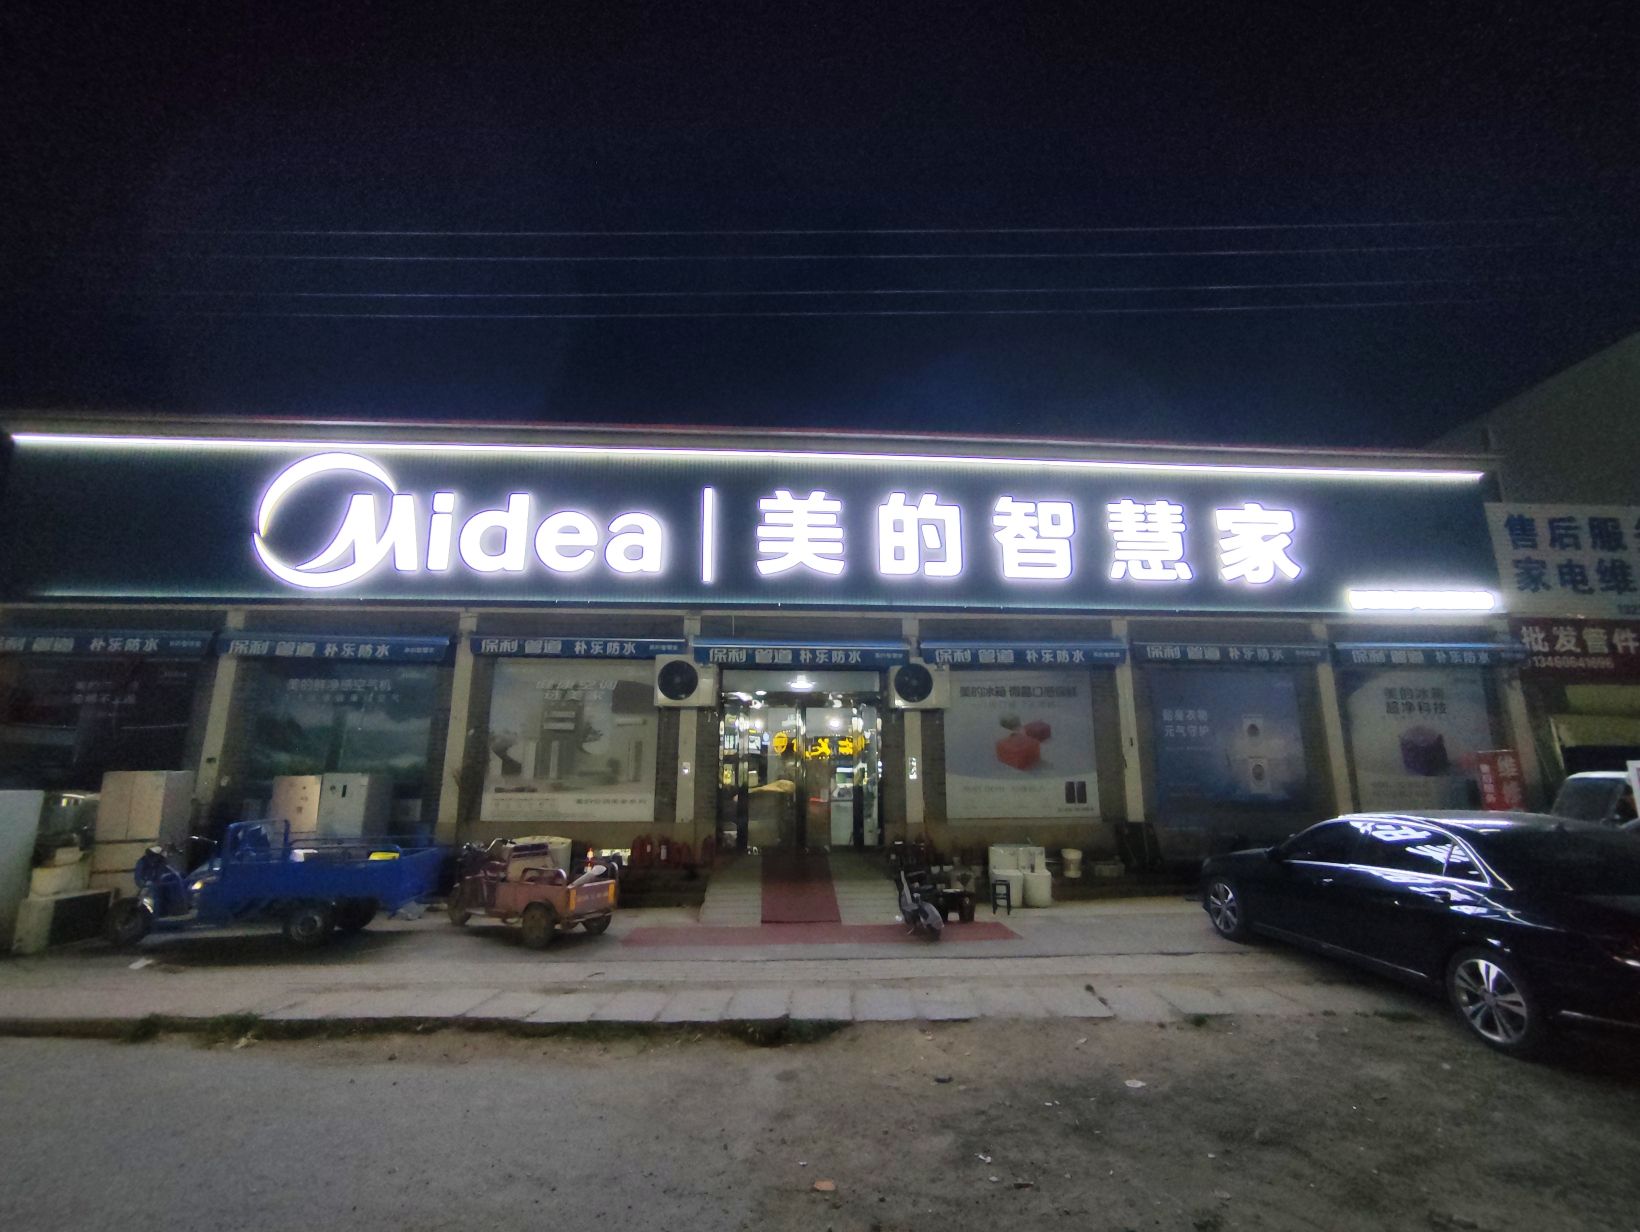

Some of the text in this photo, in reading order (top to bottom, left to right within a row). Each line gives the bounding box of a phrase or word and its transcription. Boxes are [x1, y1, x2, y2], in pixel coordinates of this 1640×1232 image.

[253, 454, 1301, 588] Midea 美的智慧家
[1504, 514, 1640, 552] 售后服
[481, 639, 518, 653] 保利
[574, 640, 636, 656] 朴乐防水
[709, 647, 746, 663] 保利
[799, 649, 862, 664] 朴乐防水
